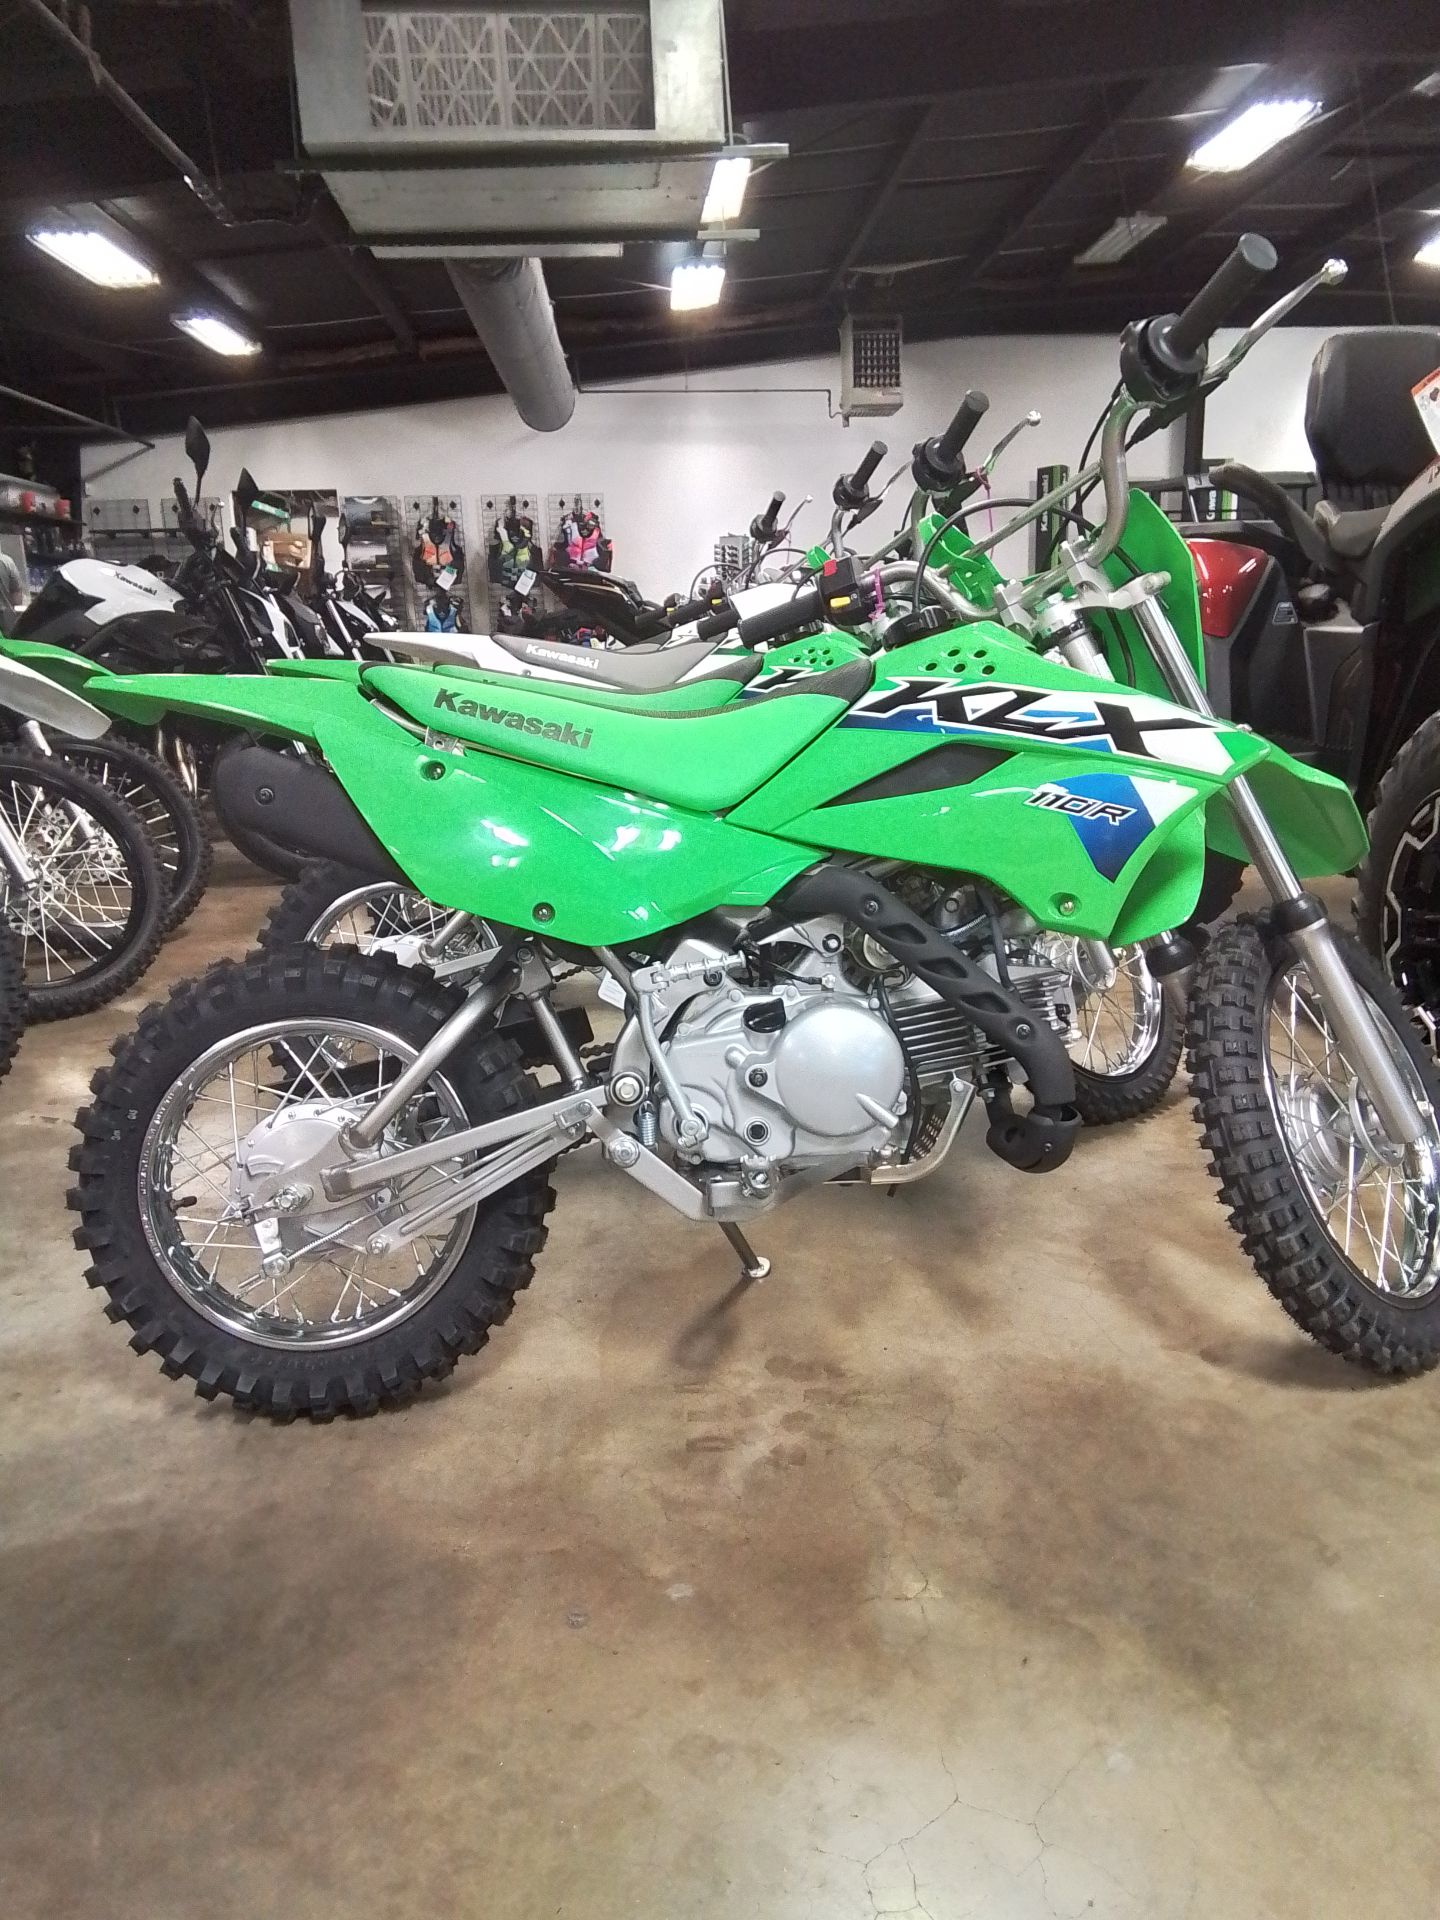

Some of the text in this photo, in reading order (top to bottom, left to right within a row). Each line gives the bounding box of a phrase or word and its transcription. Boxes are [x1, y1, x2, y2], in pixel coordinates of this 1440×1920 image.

[525, 643, 599, 670] Kawasaki
[433, 688, 594, 750] Kawasaki
[853, 679, 1218, 761] KLX
[1025, 790, 1136, 825] 110R
